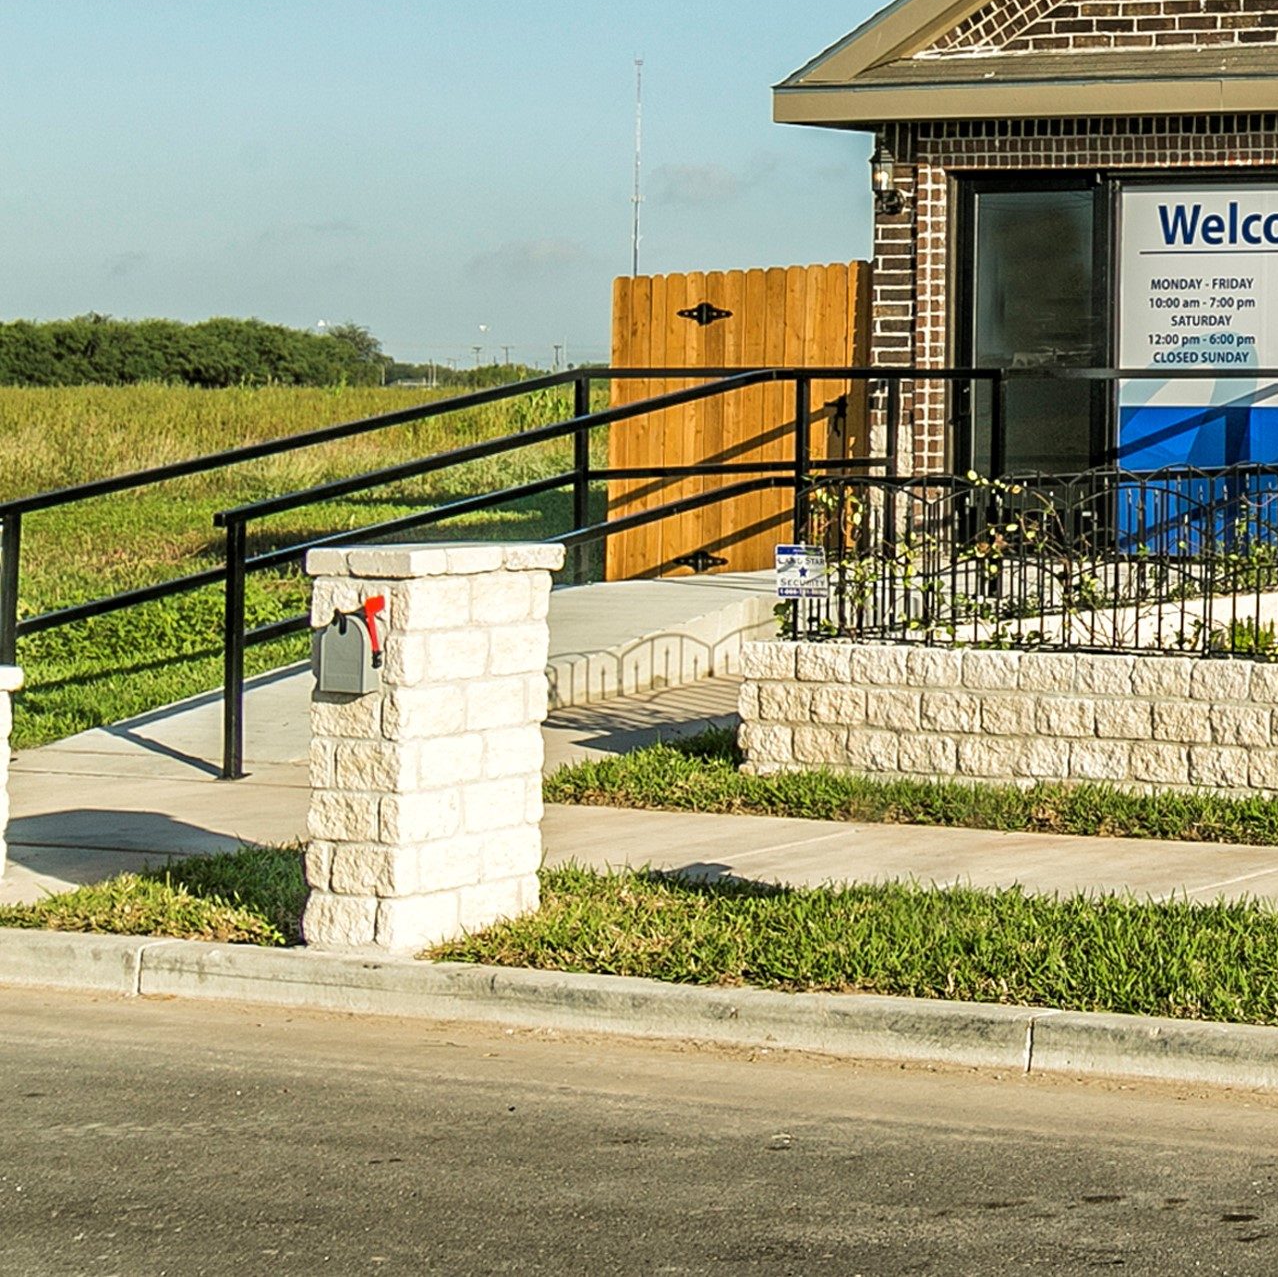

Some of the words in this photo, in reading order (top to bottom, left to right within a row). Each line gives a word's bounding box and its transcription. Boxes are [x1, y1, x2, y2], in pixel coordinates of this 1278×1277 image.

[1150, 278, 1203, 290] MONDAY
[1211, 278, 1254, 290] FRIDAY
[1149, 297, 1181, 309] 10:00
[1182, 299, 1200, 309] am
[1209, 297, 1235, 309] 7:00
[1236, 298, 1256, 311] pm
[1170, 314, 1232, 327] SATURDAY
[1148, 333, 1180, 345] 12:00
[1181, 335, 1200, 348] pm
[1209, 333, 1235, 345] 6:00
[1236, 335, 1256, 347] pm
[1153, 351, 1199, 364] CLOSED
[1200, 351, 1250, 364] SUNDAY
